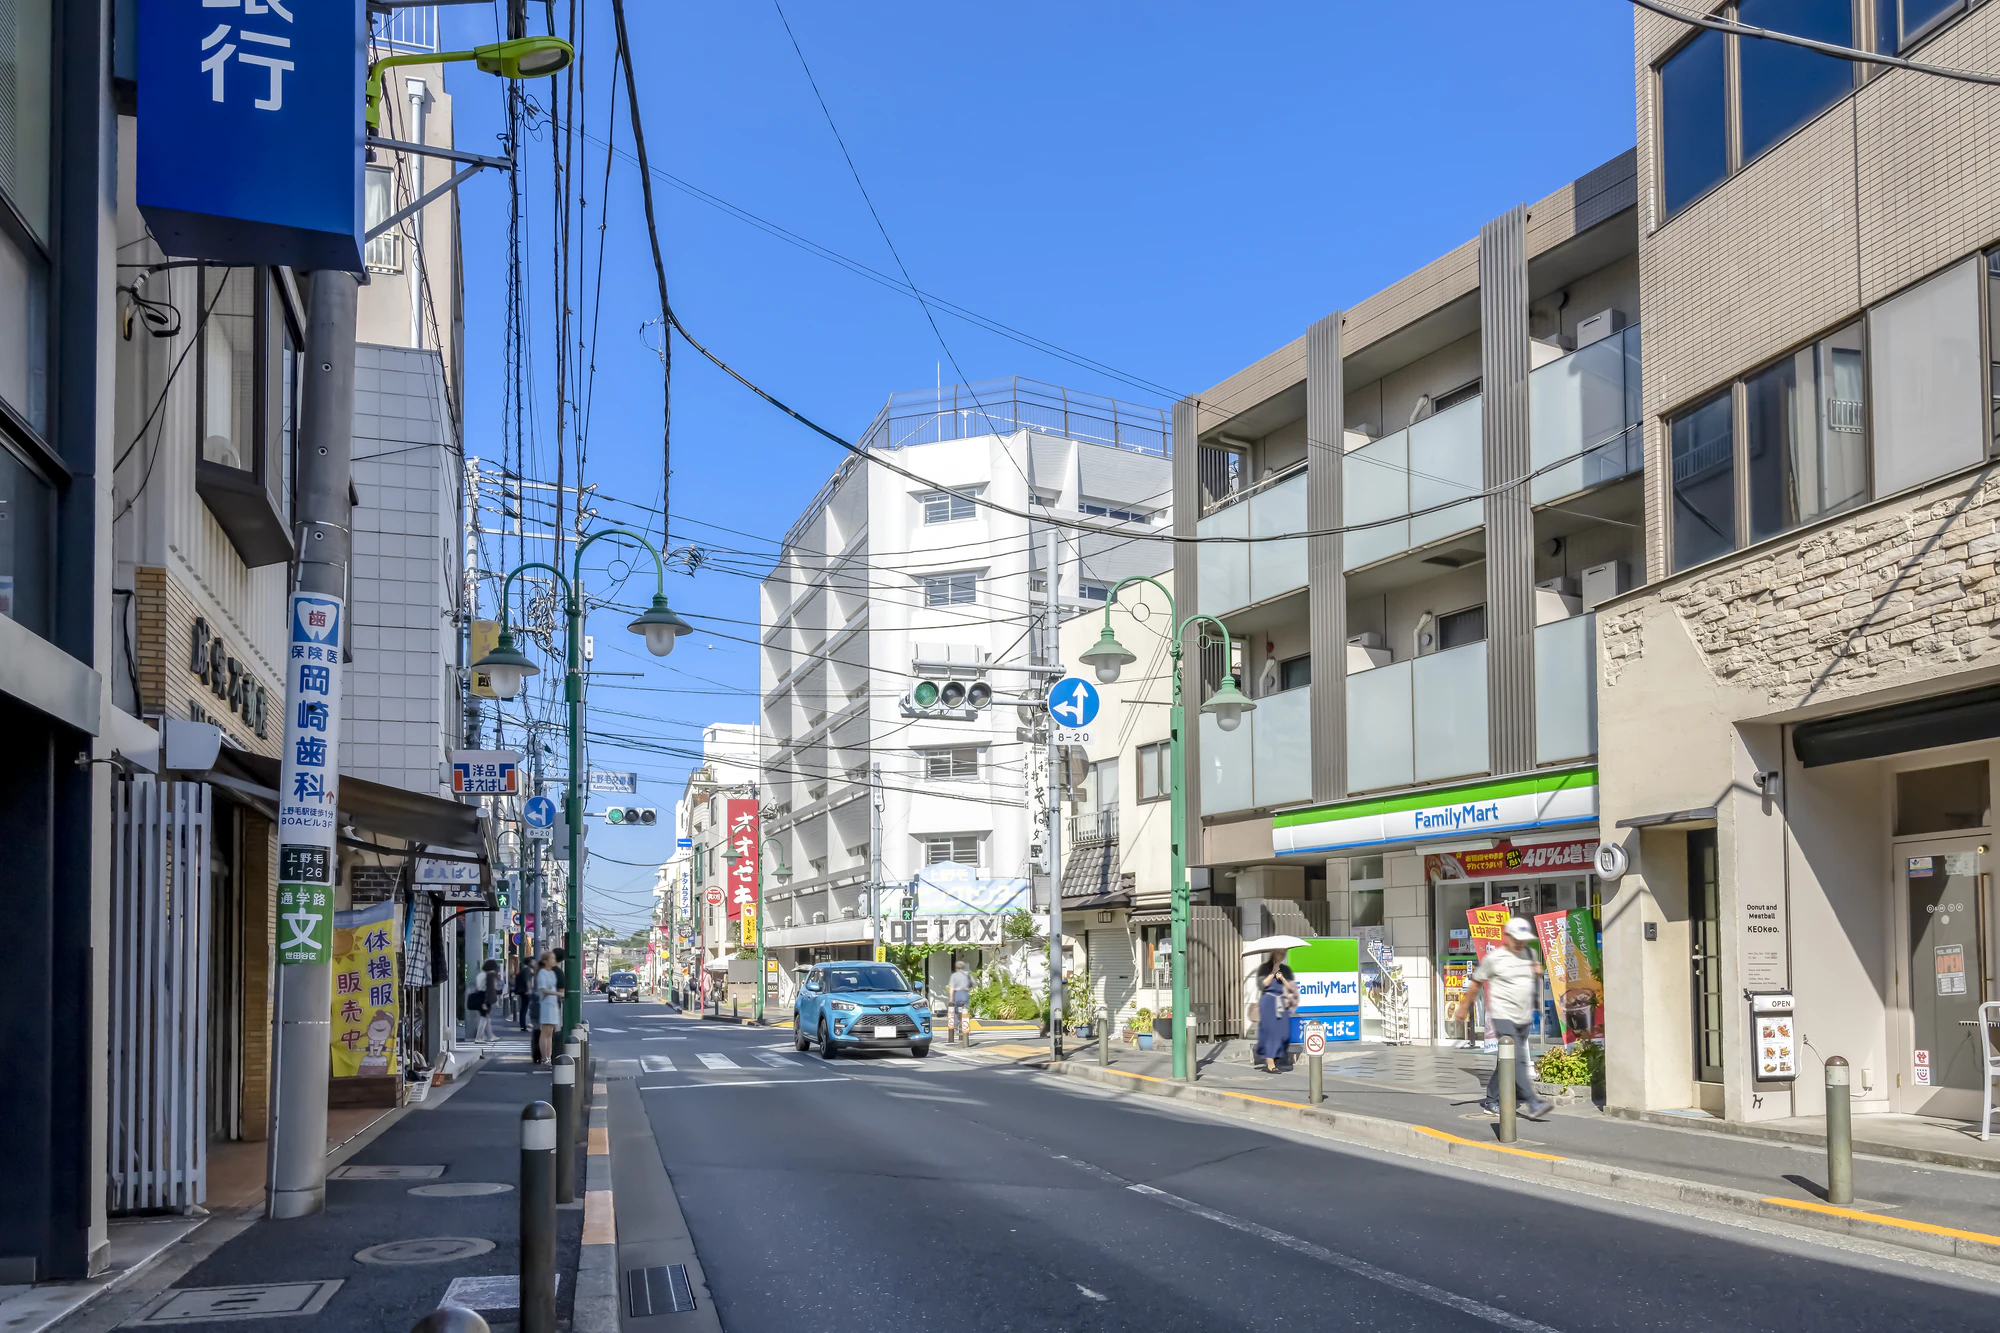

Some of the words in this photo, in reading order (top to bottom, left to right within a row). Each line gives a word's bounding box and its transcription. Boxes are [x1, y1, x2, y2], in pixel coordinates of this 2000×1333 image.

[201, 0, 295, 112] 行
[309, 610, 326, 627] 歯
[292, 645, 338, 664] 保険医
[293, 664, 330, 804] 岡崎歯科
[1058, 732, 1090, 742] 8-20
[473, 764, 497, 777] 洋品
[464, 779, 507, 792] まえばし
[281, 806, 334, 819] 上野毛駅徒歩1分
[1415, 803, 1499, 829] FamilyMart
[281, 817, 333, 828] BOAビル3F
[287, 852, 324, 864] 上野毛
[731, 811, 754, 904] オオゼキ
[1523, 842, 1598, 867] 40%増量
[288, 866, 323, 878] 1-26
[280, 892, 326, 906] 通学路
[280, 907, 323, 950] 文
[890, 919, 996, 943] DETOX
[285, 951, 317, 960] 世田谷区
[1937, 954, 1963, 974] OPEN
[364, 928, 394, 1008] 体操服
[337, 971, 363, 1050] 販売中
